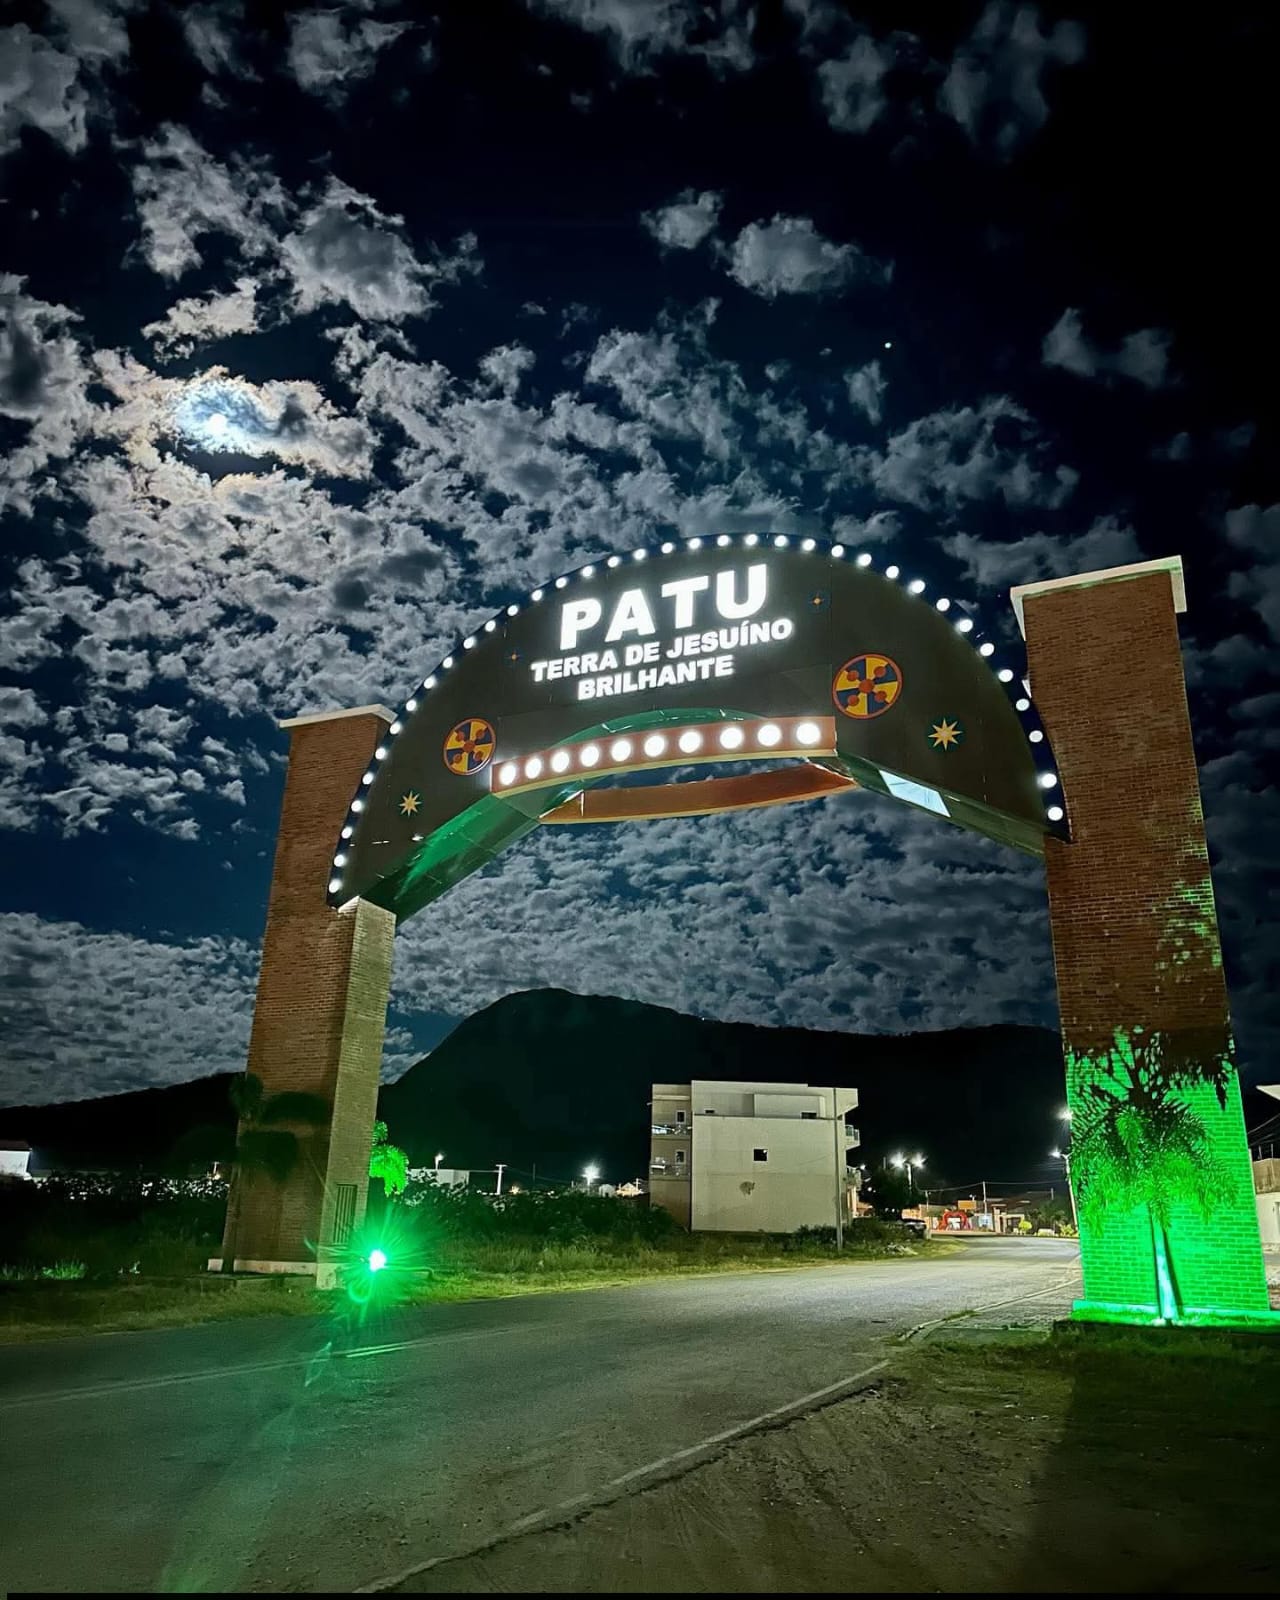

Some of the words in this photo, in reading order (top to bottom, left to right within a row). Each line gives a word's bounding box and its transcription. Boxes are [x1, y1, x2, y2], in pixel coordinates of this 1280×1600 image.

[560, 564, 767, 650] PATU
[531, 650, 618, 682] TERRA
[625, 642, 660, 666] DE
[666, 618, 793, 659] JESUÍNO
[578, 654, 735, 700] BRILHANTE
